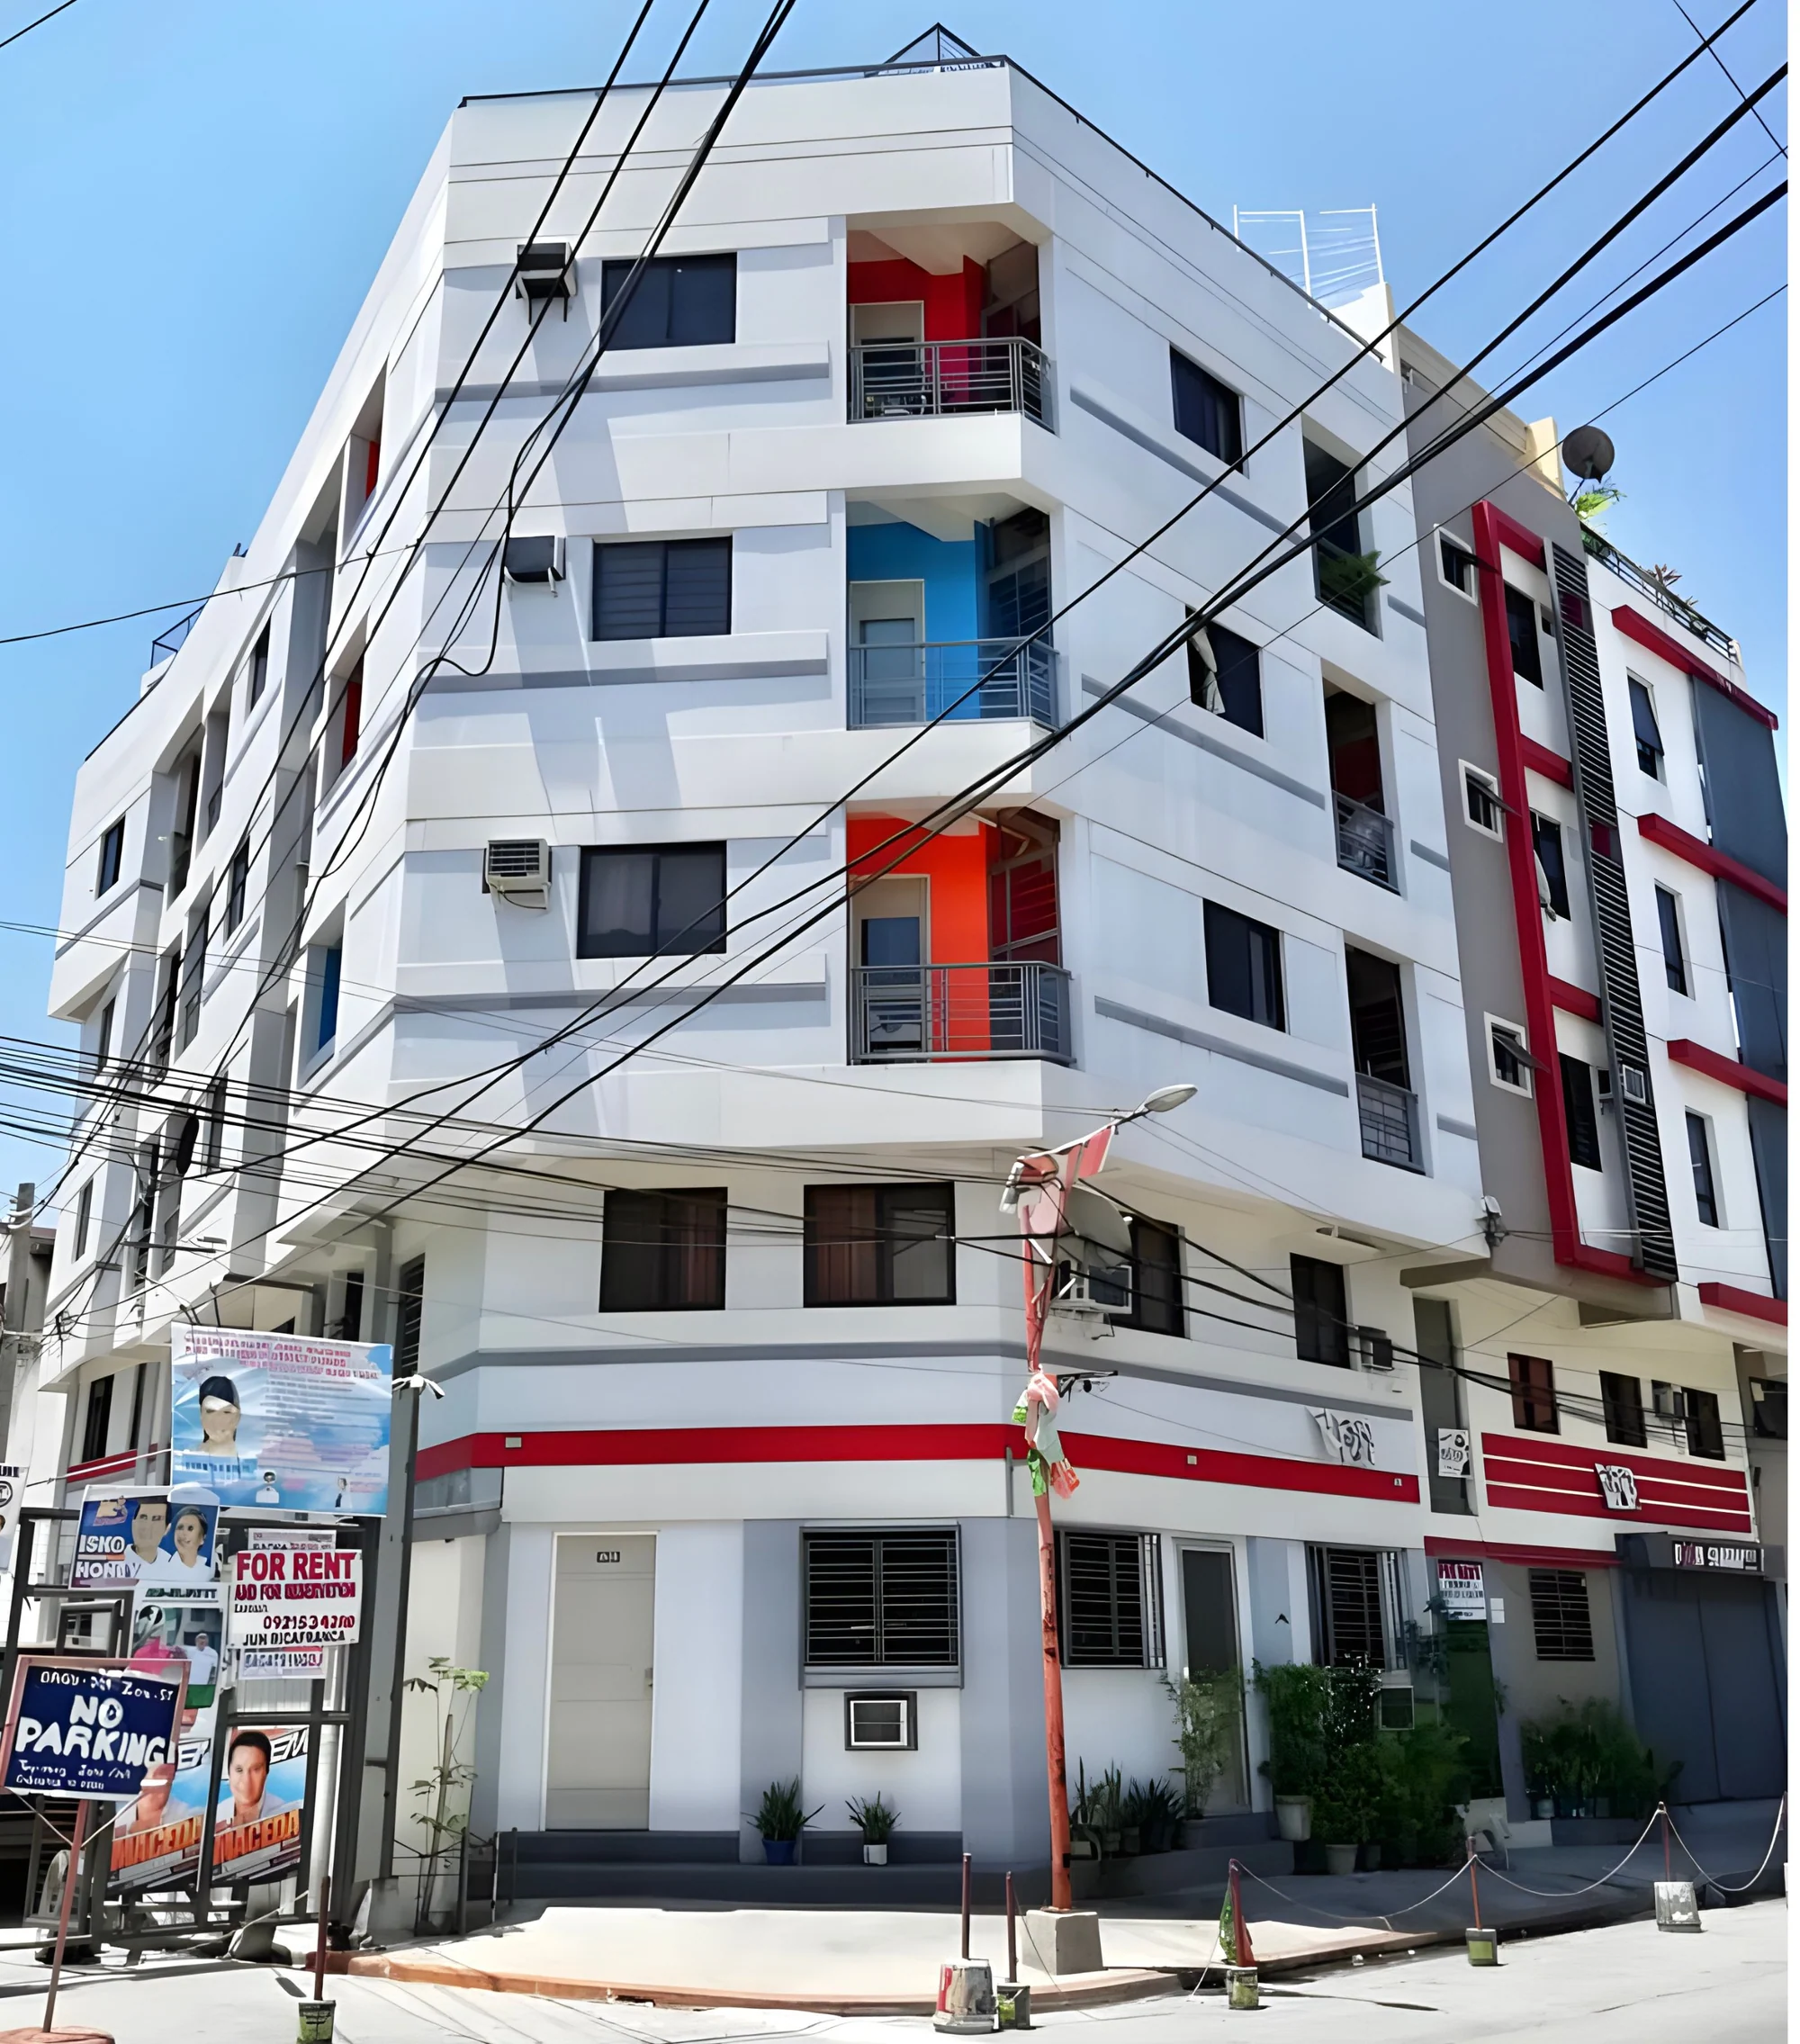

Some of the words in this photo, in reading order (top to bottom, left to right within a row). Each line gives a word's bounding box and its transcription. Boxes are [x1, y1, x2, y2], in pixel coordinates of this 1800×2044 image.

[78, 1535, 125, 1553] ISKO
[237, 1553, 285, 1580] FOR
[293, 1552, 357, 1580] RENT
[69, 1694, 124, 1729] NO
[14, 1716, 166, 1769] PARKING
